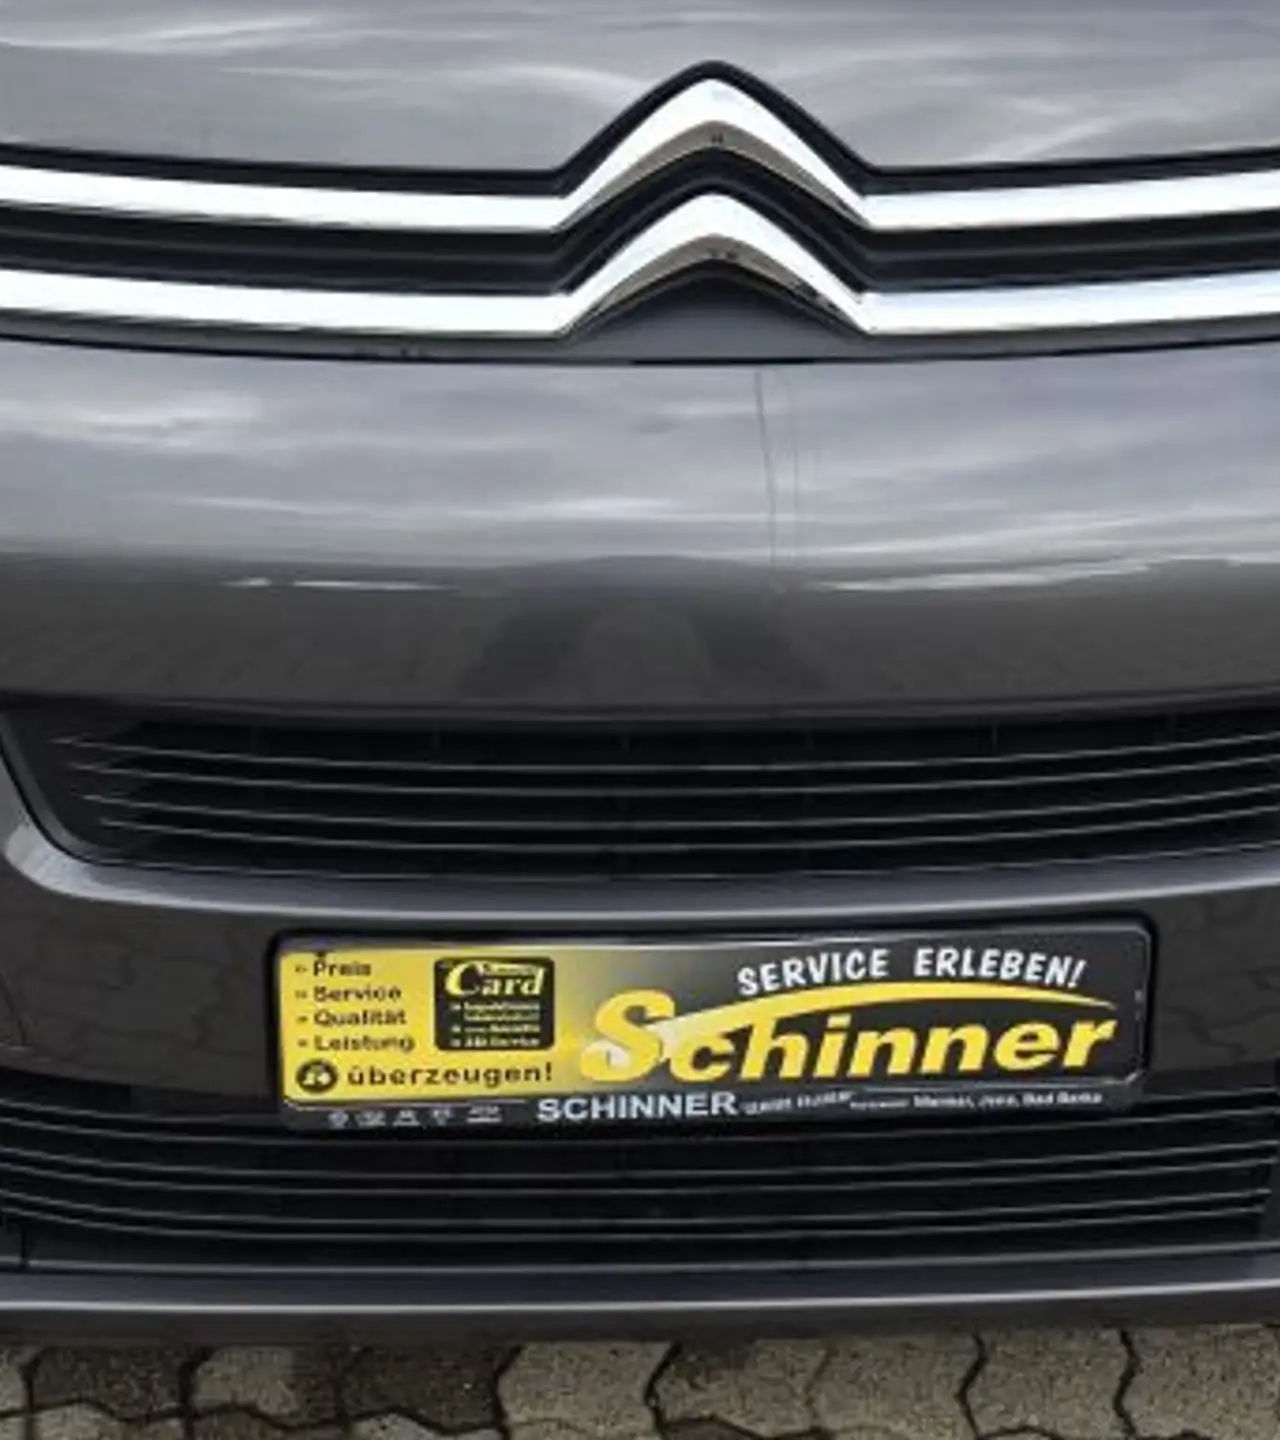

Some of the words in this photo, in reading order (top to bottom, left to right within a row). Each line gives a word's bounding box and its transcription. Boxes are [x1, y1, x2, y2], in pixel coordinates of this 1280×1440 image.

[312, 960, 372, 977] Preis
[445, 960, 545, 996] Card
[737, 948, 889, 996] SERVICE
[912, 948, 1086, 989] ERLEBEN!
[313, 985, 402, 1003] Service
[313, 1008, 407, 1028] Qualität
[313, 1034, 416, 1053] Leistung
[579, 988, 1118, 1083] Schinner
[347, 1061, 553, 1088] überzeugen!
[537, 1091, 738, 1122] SCHINNER
